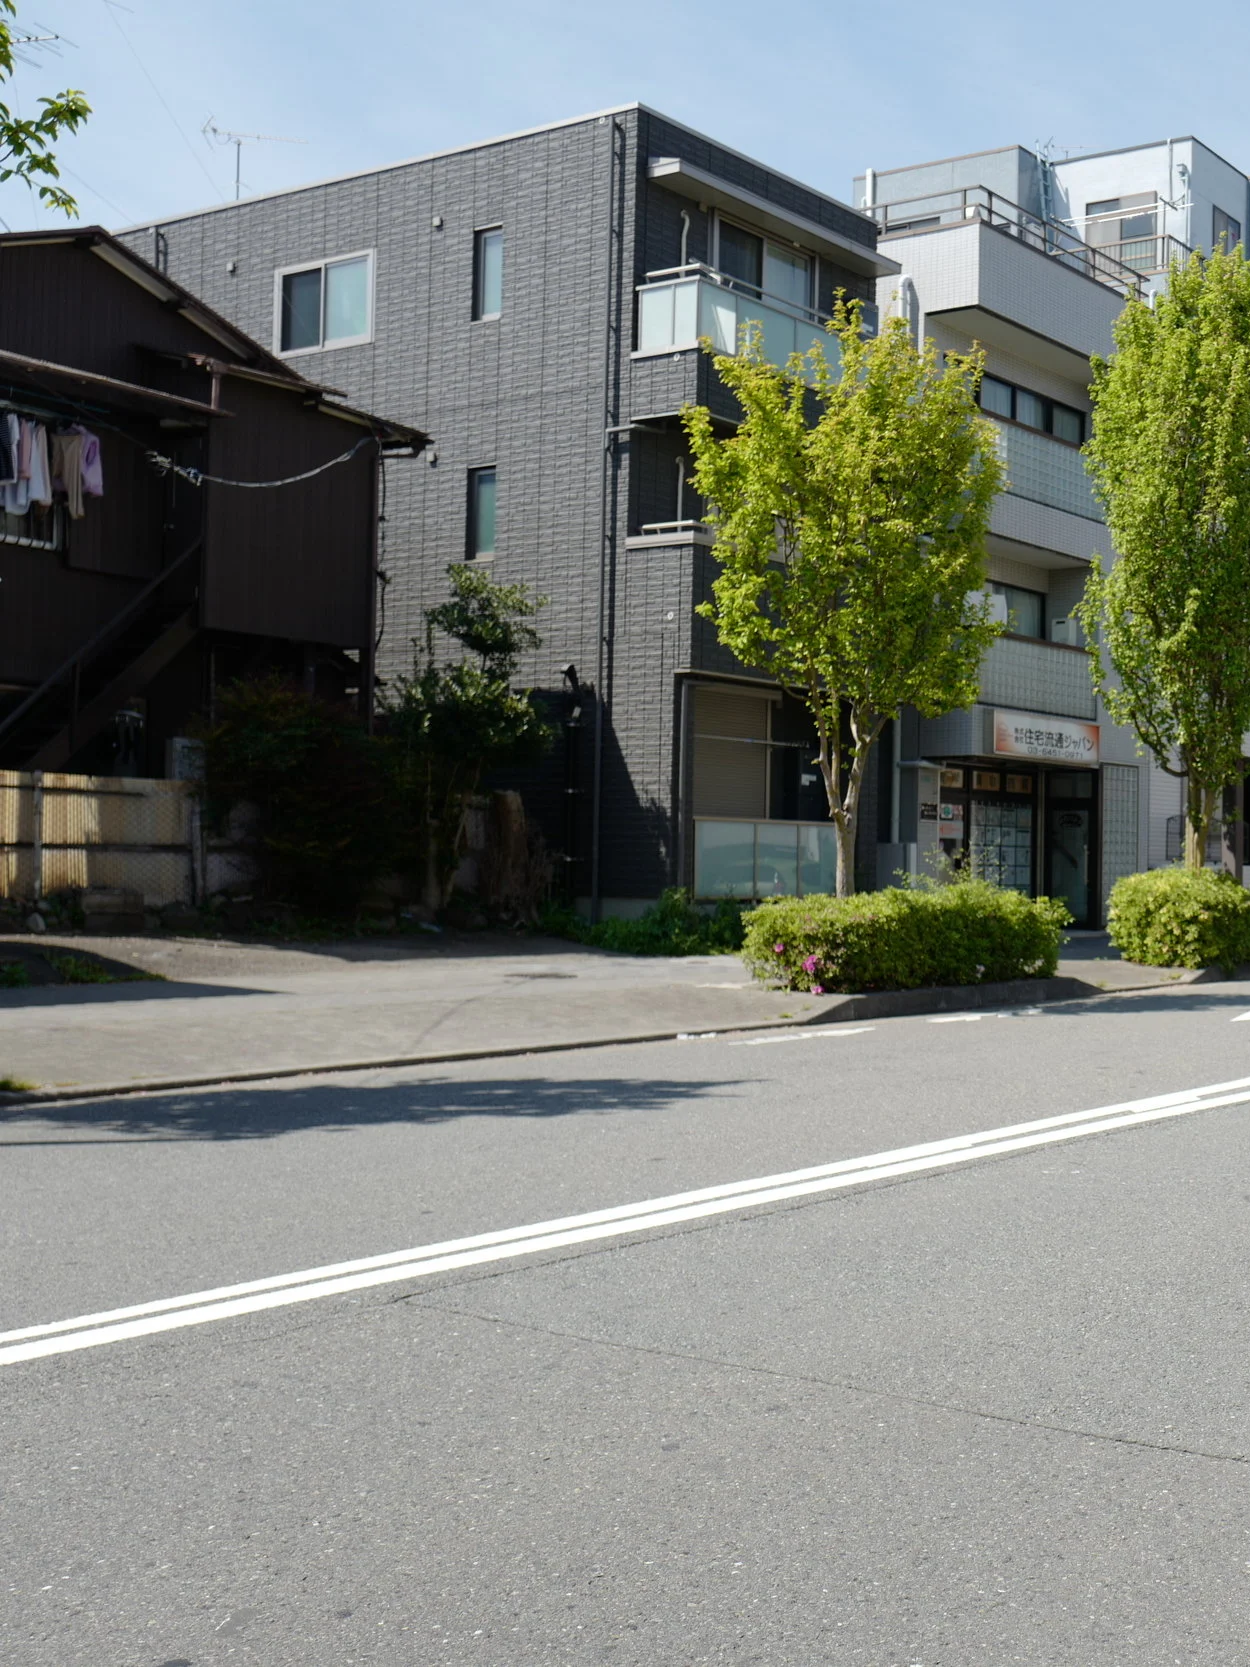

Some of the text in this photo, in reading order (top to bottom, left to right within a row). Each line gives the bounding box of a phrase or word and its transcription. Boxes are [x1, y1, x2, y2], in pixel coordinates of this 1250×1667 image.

[1024, 728, 1094, 751] 住宅流通ジャパン
